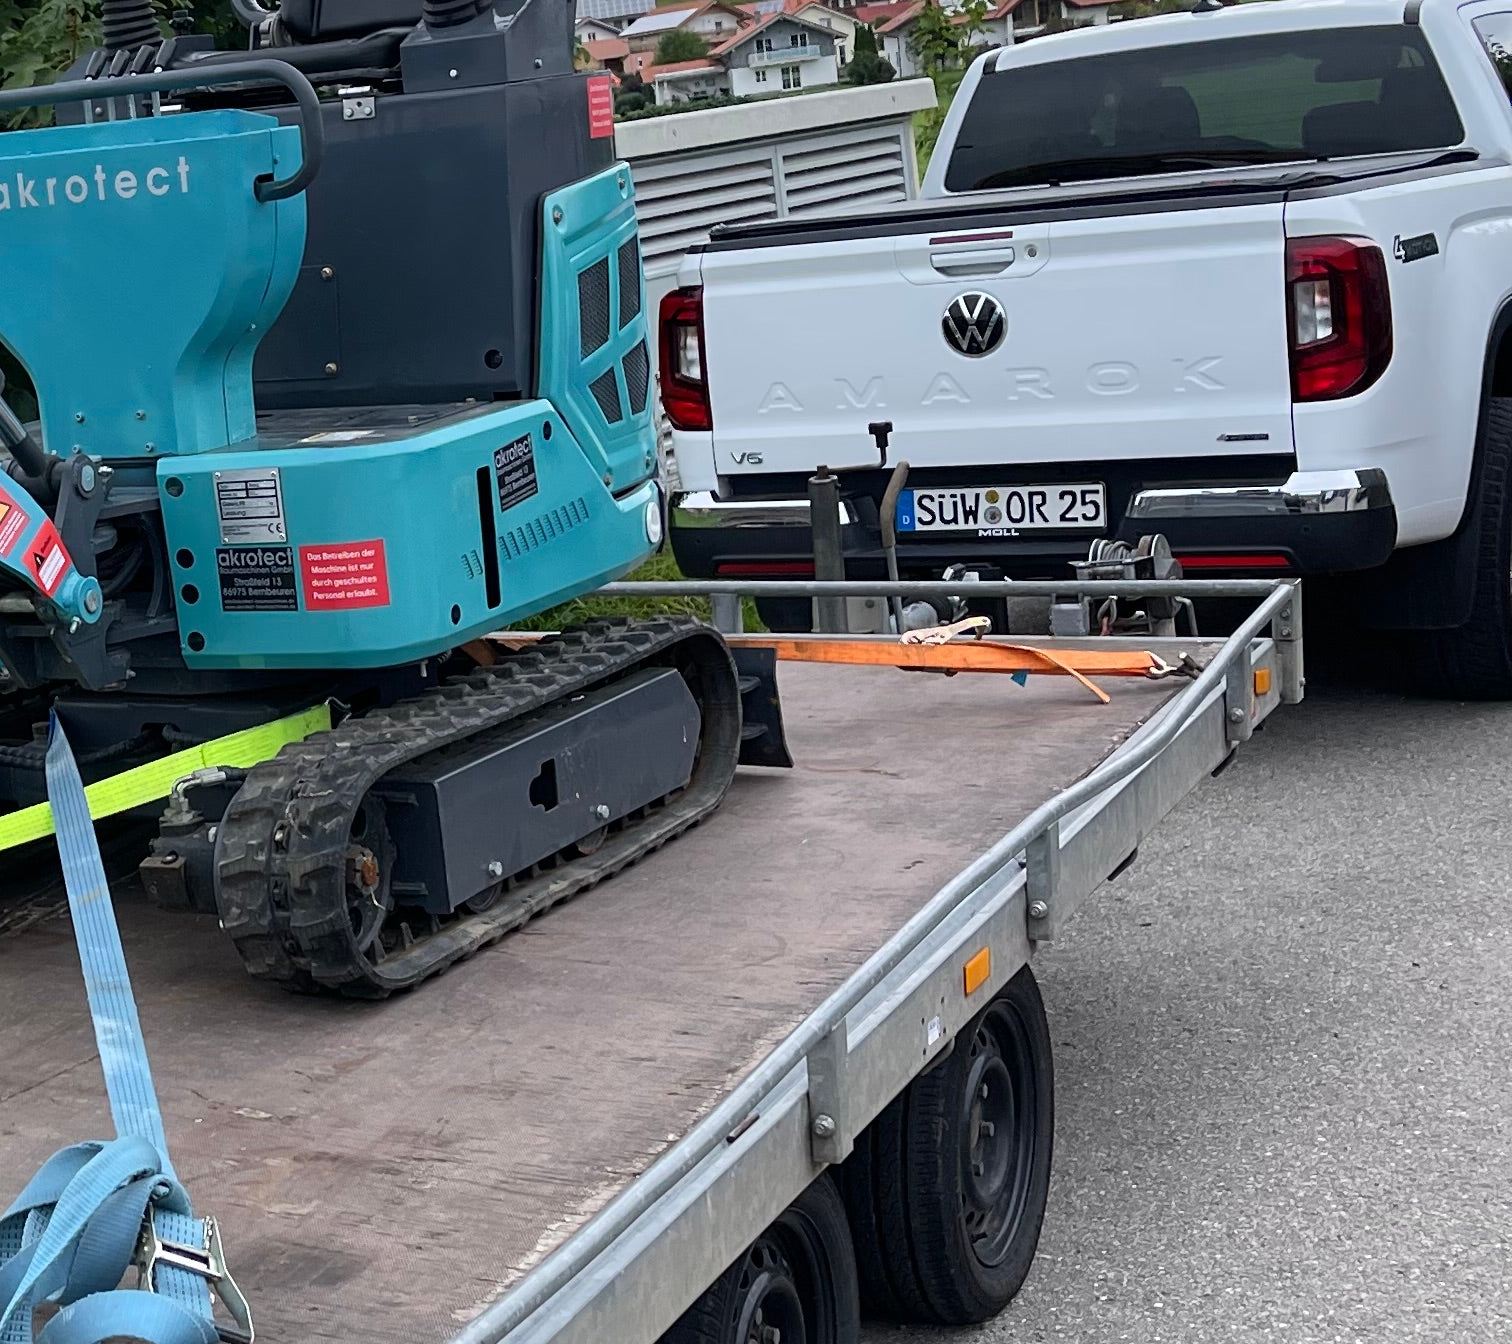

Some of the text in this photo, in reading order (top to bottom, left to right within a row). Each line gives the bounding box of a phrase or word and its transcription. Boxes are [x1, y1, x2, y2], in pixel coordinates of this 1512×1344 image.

[757, 356, 1226, 414] AMAROK
[730, 452, 763, 464] V6
[901, 489, 1101, 526] D SÜW OR 25
[978, 528, 1020, 537] MOLL
[218, 548, 293, 566] akrotect
[307, 549, 375, 561] Das Betreiben der
[311, 563, 374, 574] Maschine ist nur
[311, 576, 377, 587] durch geschultes
[313, 589, 378, 600] Personal erlaubt.
